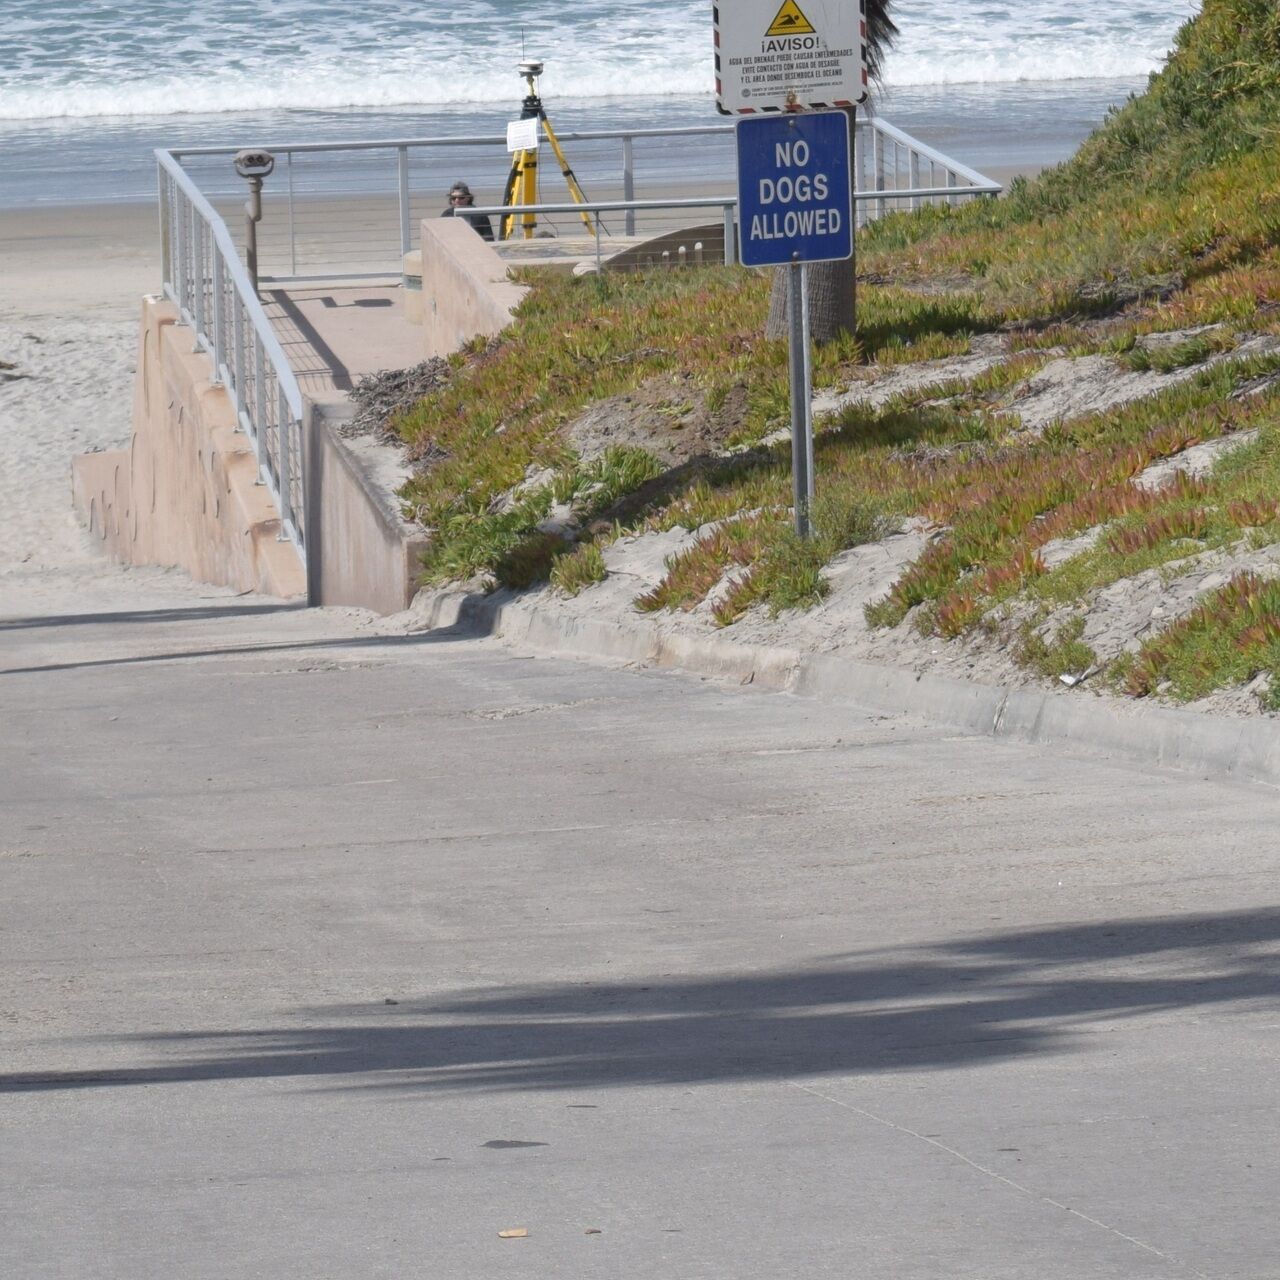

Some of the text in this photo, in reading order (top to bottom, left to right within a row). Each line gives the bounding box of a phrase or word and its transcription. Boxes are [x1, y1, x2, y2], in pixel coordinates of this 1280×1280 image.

[762, 37, 819, 53] ¡AVISO!
[754, 55, 774, 63] DRENAJE
[794, 52, 813, 60] CAUSAR
[815, 49, 852, 58] ENFERMEDADES
[742, 66, 754, 74] EVITE
[757, 64, 782, 73] CONTACTO
[745, 75, 751, 83] EL
[767, 73, 782, 81] DONDE
[785, 71, 814, 79] DESEMBOCA
[776, 140, 809, 167] NO
[760, 174, 828, 204] DOGS
[750, 209, 840, 240] ALLOWED
